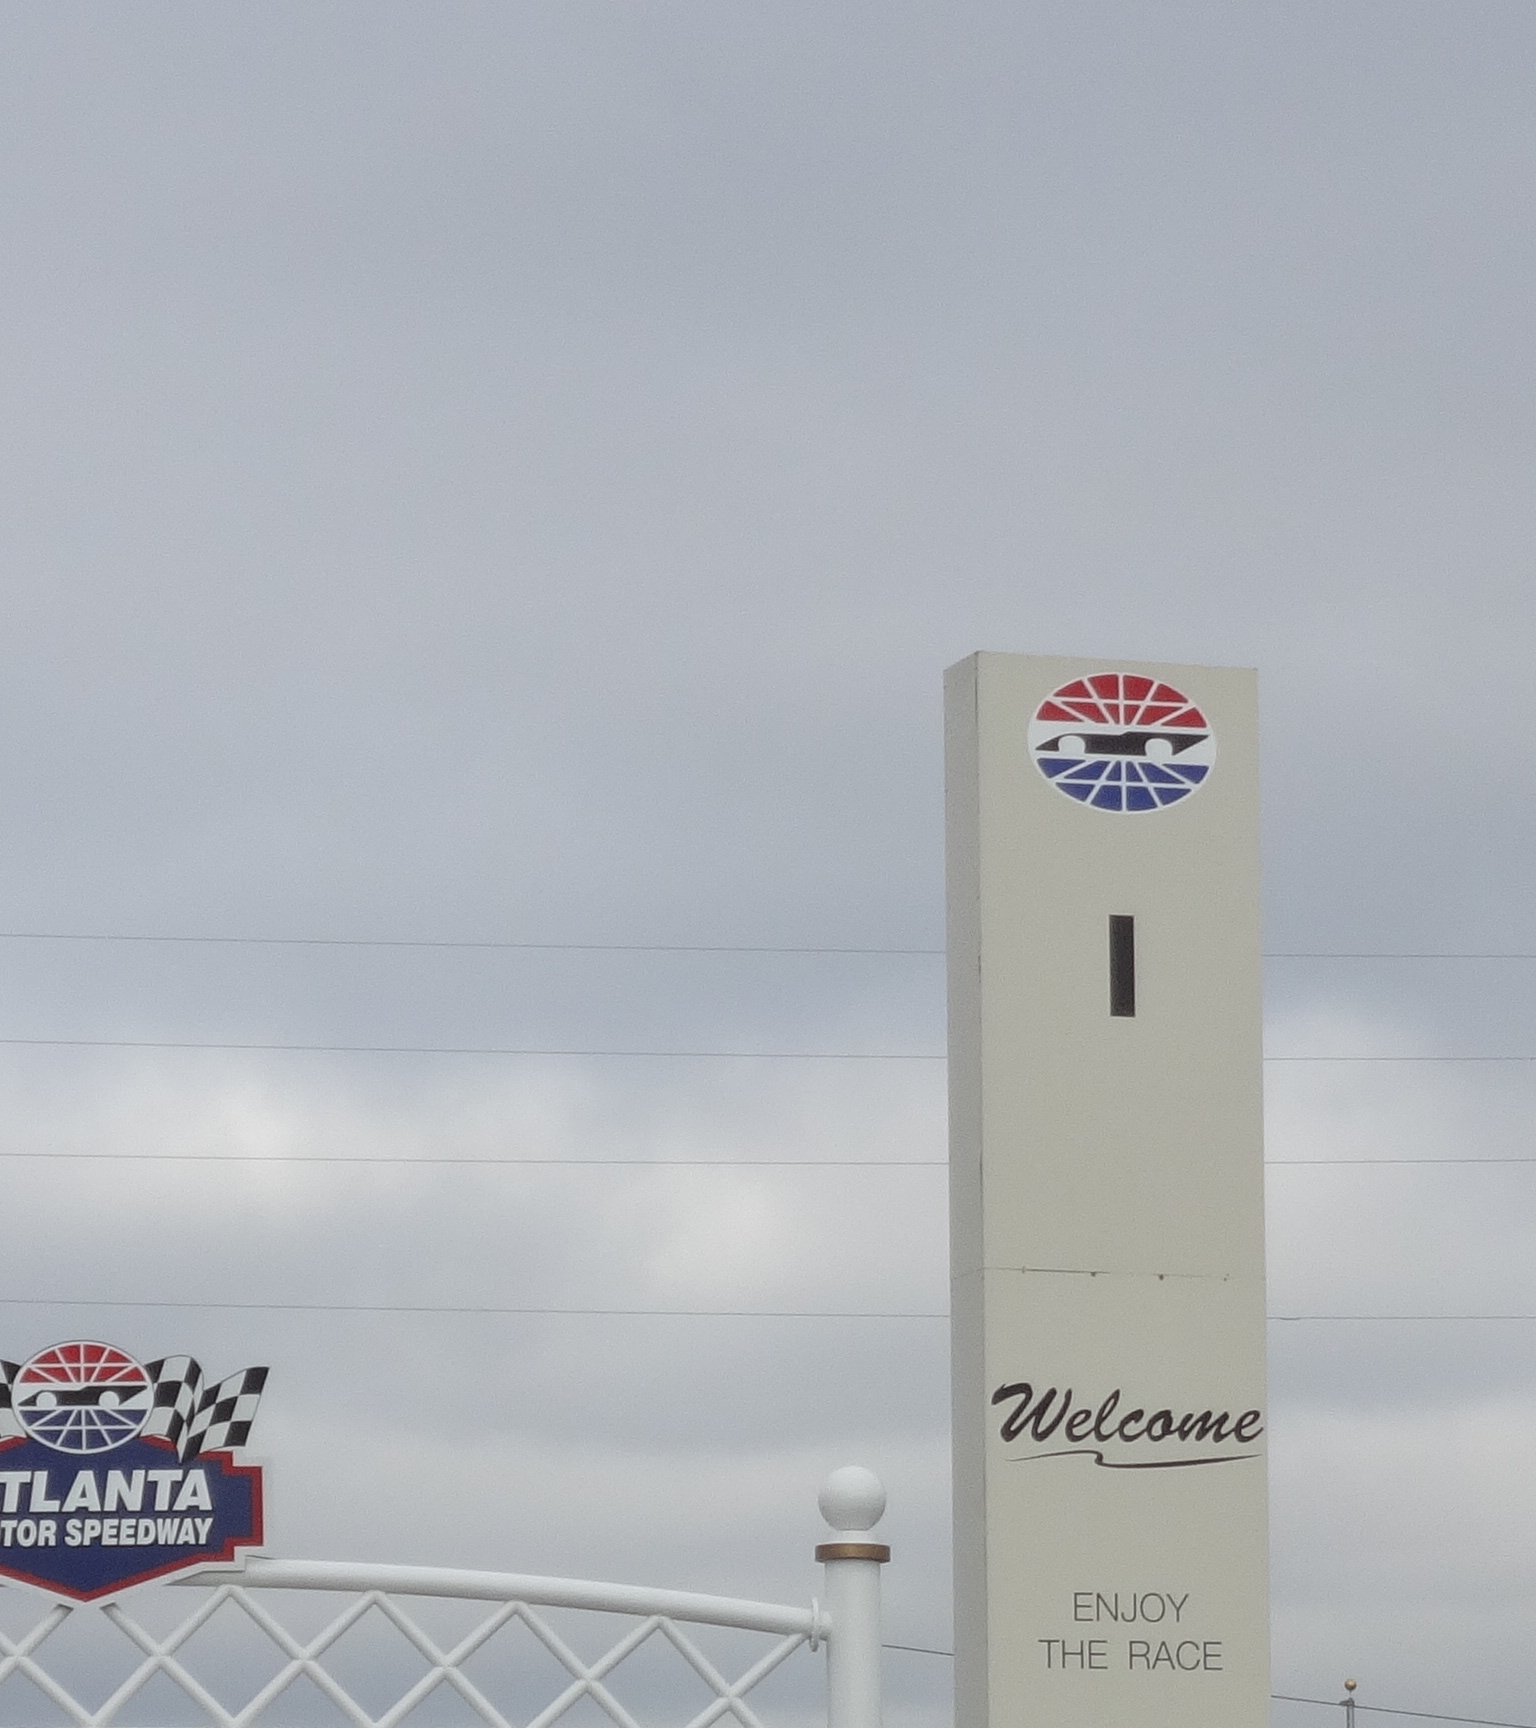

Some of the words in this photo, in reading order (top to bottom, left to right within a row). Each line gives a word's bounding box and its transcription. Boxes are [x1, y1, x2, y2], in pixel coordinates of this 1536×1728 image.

[991, 1382, 1264, 1443] Welcome
[64, 1517, 213, 1546] SPEEDWAY
[1073, 1592, 1189, 1623] ENJOY
[1038, 1640, 1108, 1669] THE
[1129, 1641, 1223, 1670] RACE
